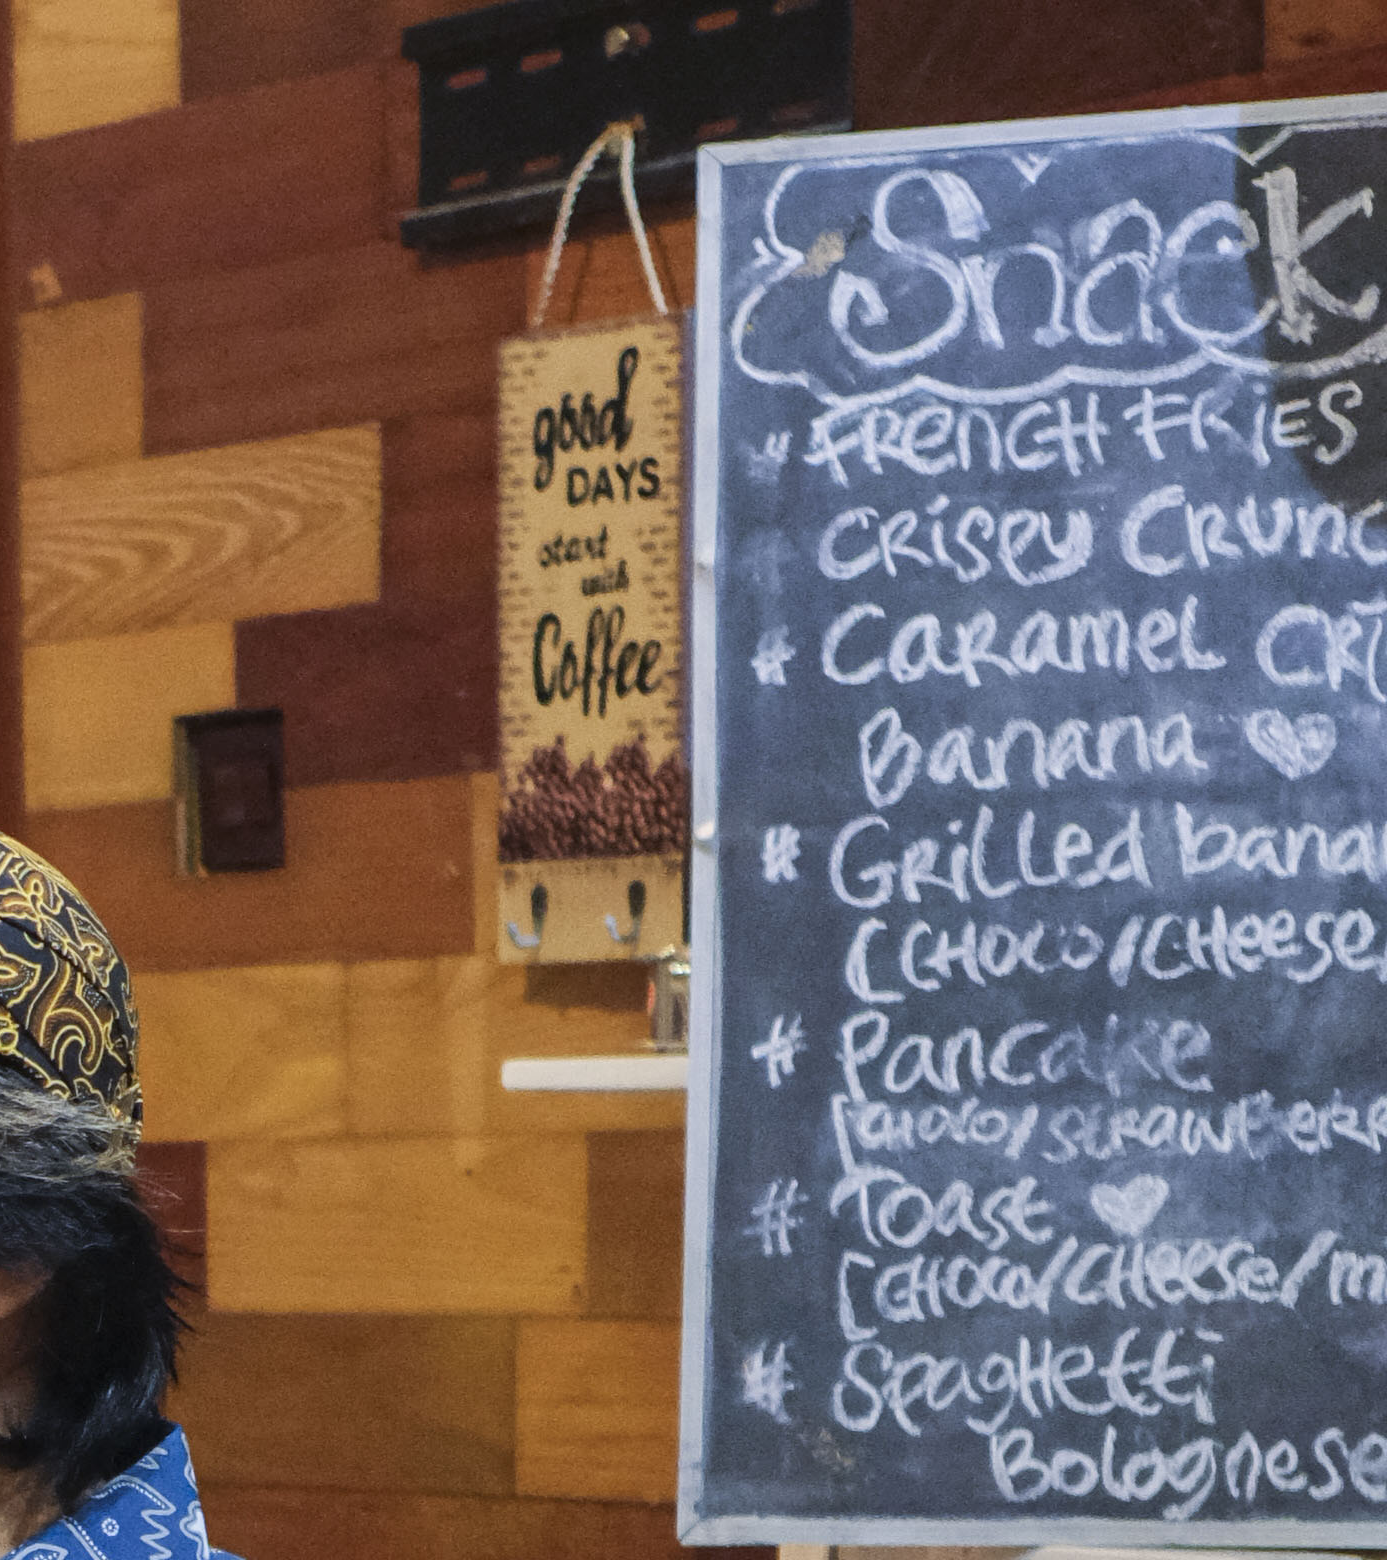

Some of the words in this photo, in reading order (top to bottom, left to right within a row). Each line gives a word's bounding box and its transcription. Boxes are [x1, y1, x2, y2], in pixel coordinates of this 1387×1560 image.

[533, 346, 640, 493] good
[566, 456, 661, 508] DAYS
[539, 524, 609, 570] start
[532, 604, 662, 719] Coffee
[858, 706, 1209, 810] Banana
